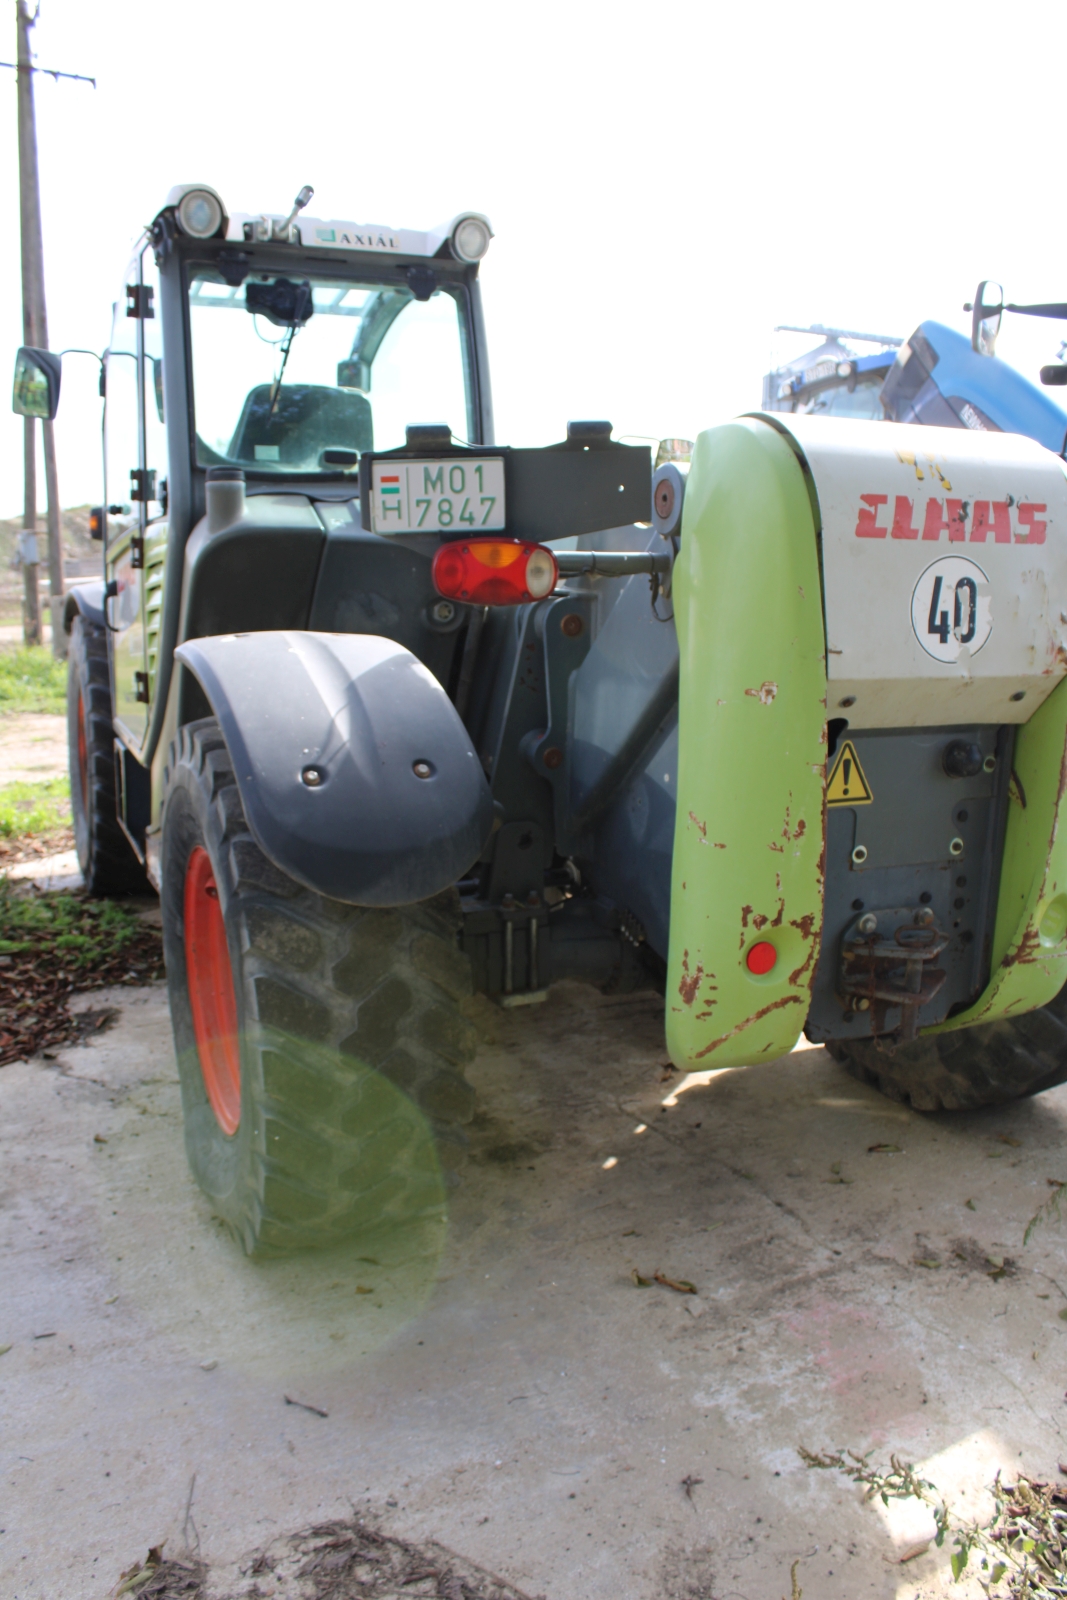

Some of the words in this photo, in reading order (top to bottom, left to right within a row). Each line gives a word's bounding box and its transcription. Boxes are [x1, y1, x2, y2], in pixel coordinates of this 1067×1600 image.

[340, 233, 399, 248] AXIÁL
[381, 499, 402, 521] H
[415, 497, 496, 527] 7847
[855, 493, 1048, 545] CLAAS
[928, 576, 977, 643] 40
